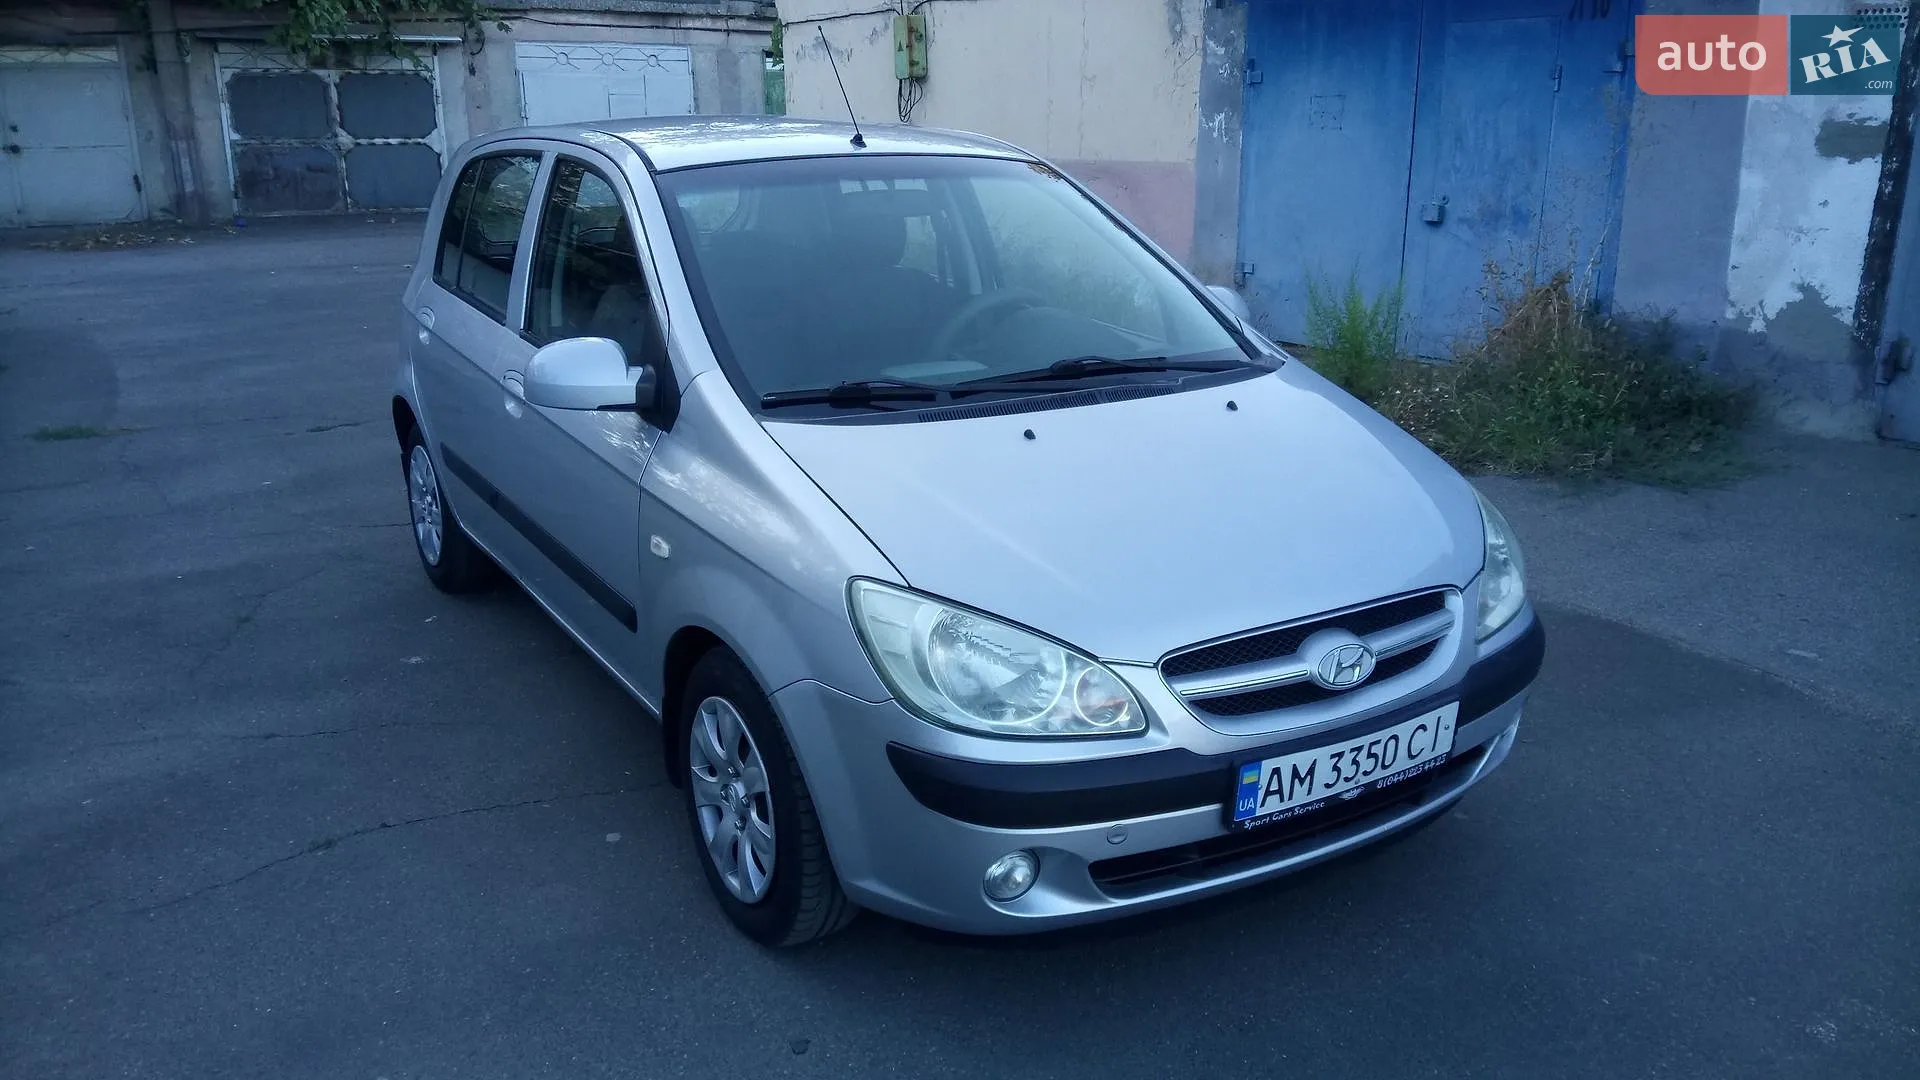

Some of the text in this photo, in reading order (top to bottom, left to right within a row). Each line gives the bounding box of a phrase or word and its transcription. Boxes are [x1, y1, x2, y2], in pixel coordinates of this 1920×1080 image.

[1260, 757, 1317, 809] AM
[1324, 734, 1400, 789] 3350
[1239, 797, 1255, 811] UA
[1243, 801, 1325, 830] Sport Cars Service
